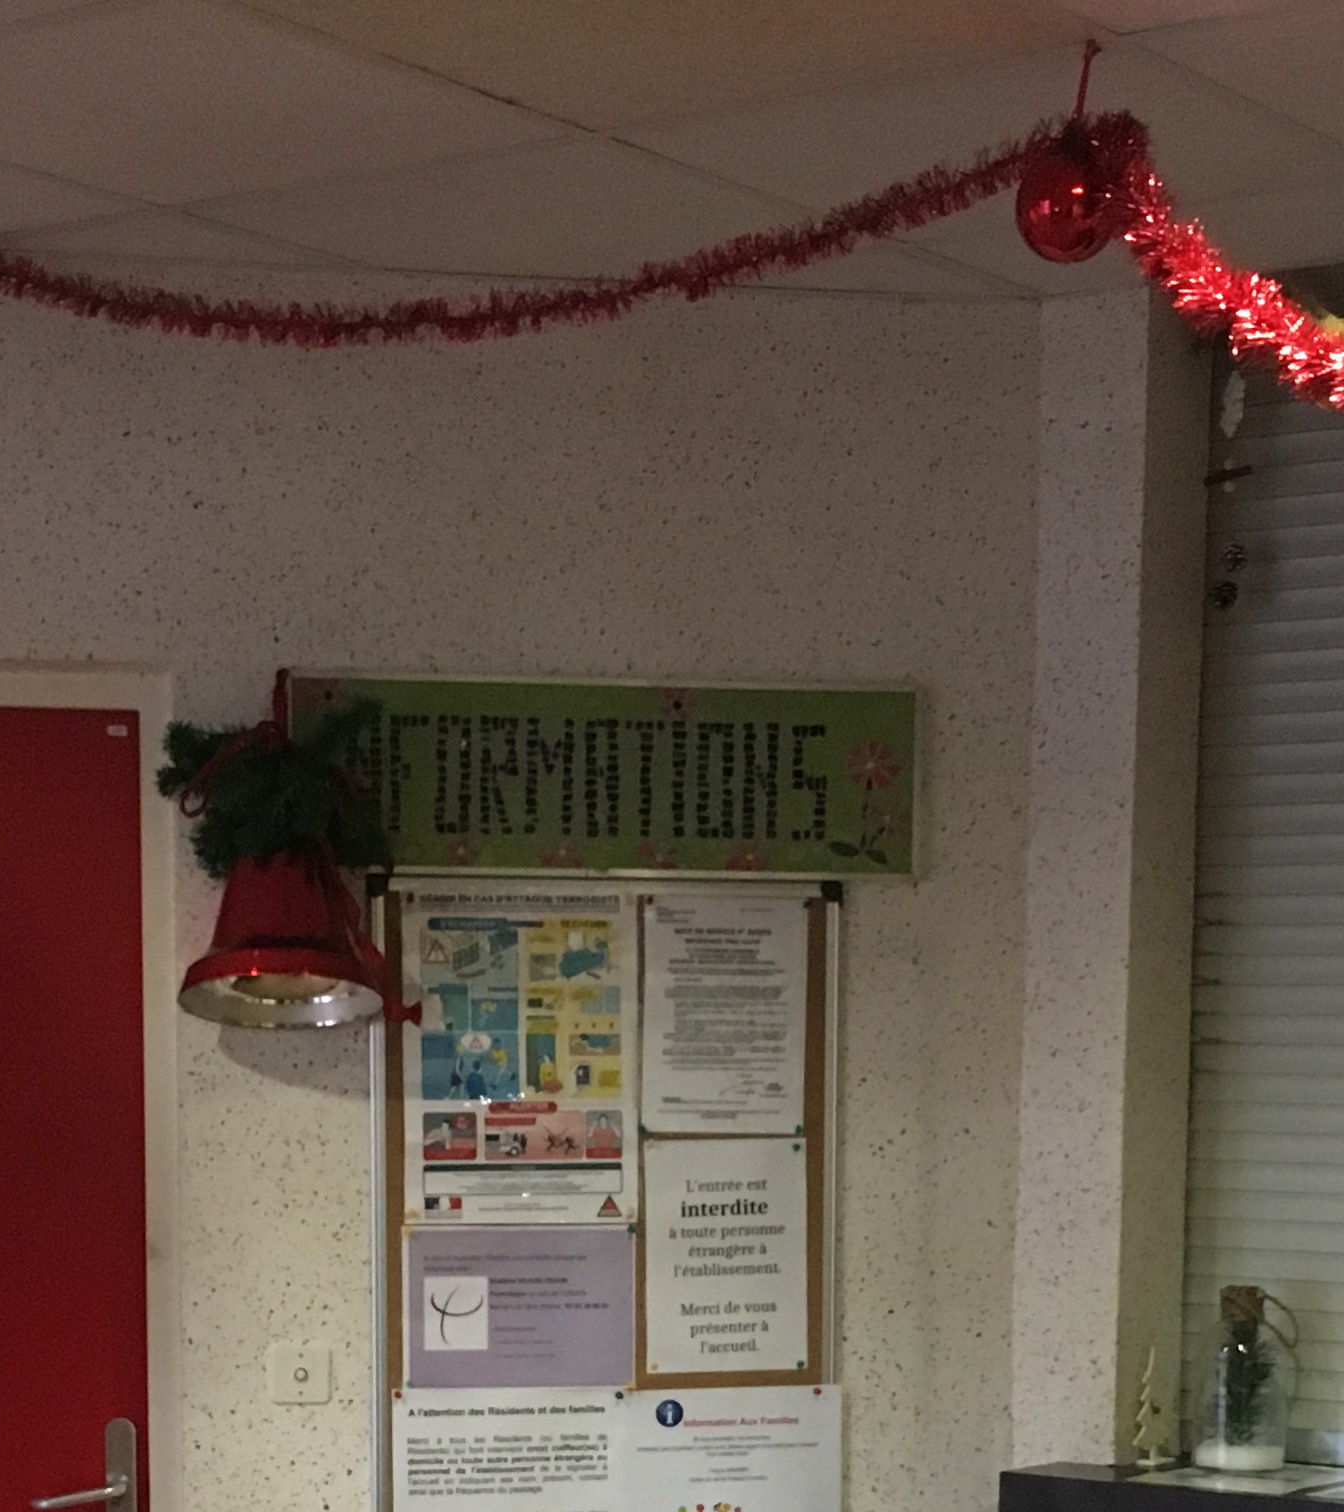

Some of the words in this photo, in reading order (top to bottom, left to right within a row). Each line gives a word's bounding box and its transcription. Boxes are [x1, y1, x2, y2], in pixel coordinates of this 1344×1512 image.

[346, 712, 828, 842] FORMATIONS
[686, 1179, 743, 1193] L'entrée
[746, 1178, 768, 1192] est
[680, 1199, 769, 1218] interdite
[669, 1227, 677, 1239] à
[680, 1227, 717, 1239] toute
[720, 1224, 786, 1240] personne
[688, 1245, 755, 1260] étrangère
[759, 1243, 767, 1255] à
[680, 1303, 720, 1316] Merci
[723, 1301, 741, 1314] de
[744, 1302, 777, 1313] vous
[690, 1321, 758, 1339] présenter
[761, 1319, 769, 1332] à
